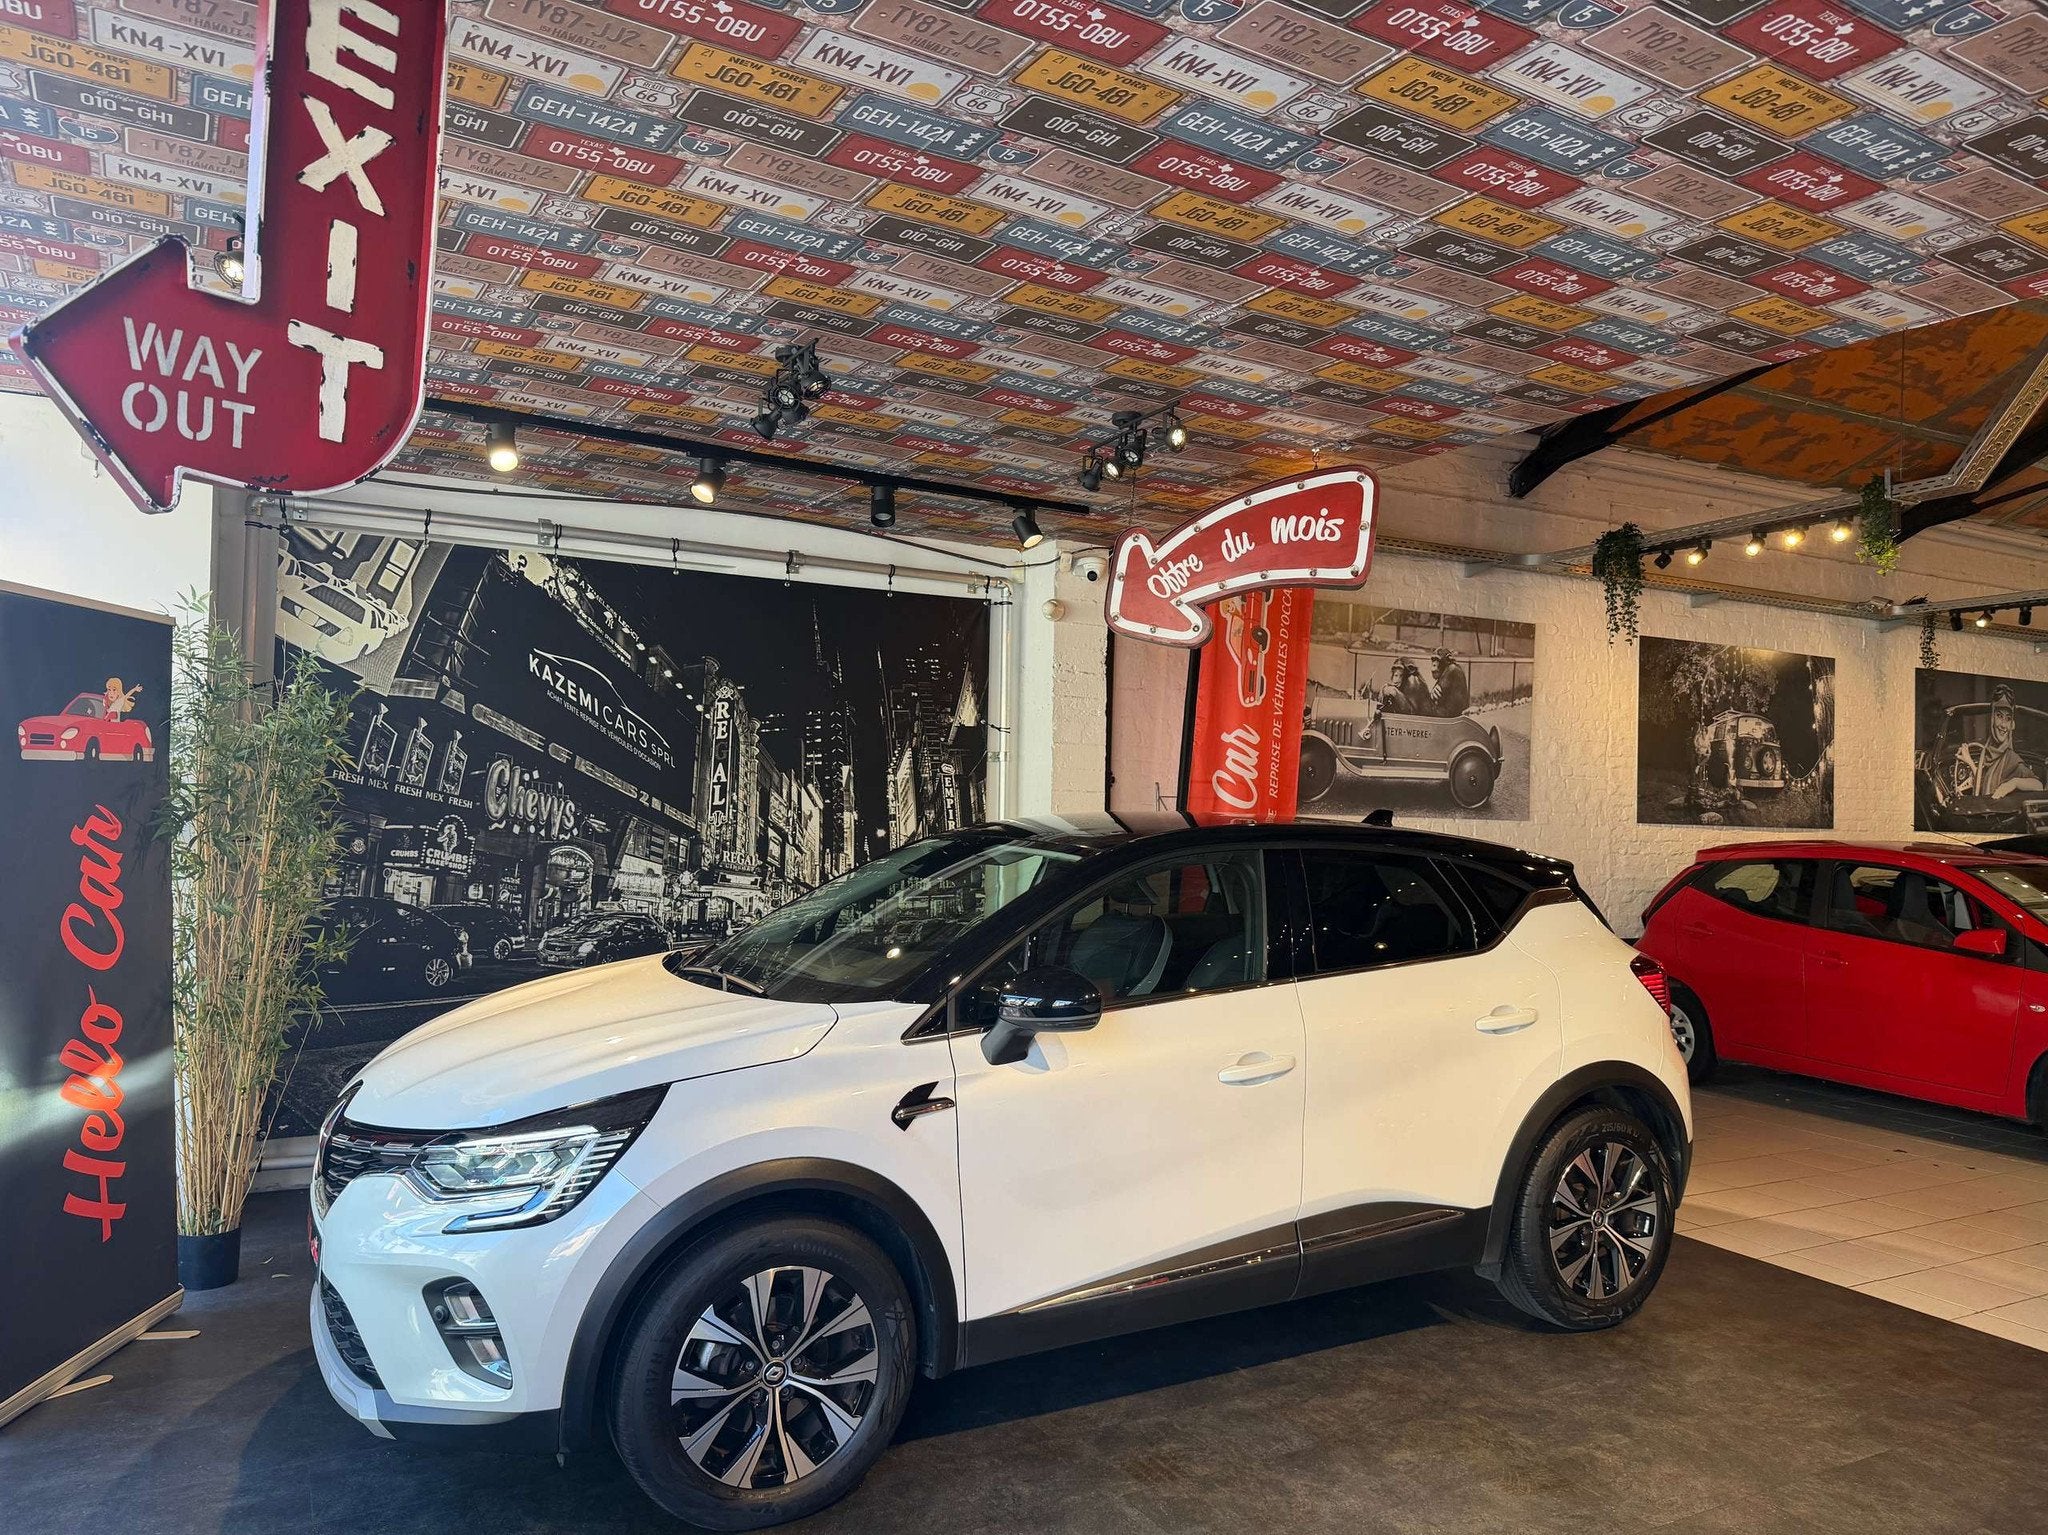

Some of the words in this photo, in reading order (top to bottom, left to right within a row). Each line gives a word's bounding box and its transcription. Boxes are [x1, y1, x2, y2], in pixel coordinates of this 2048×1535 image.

[529, 94, 637, 136] GEH-142A
[636, 89, 658, 102] 66
[967, 96, 990, 110] 66
[1297, 105, 1323, 118] 66
[78, 125, 98, 139] 15
[853, 104, 955, 145] GEH-142A
[1177, 111, 1273, 152] GEH-142A
[1628, 110, 1656, 123] 66
[1959, 115, 1989, 128] 66
[692, 140, 712, 153] 15
[998, 148, 1020, 160] 15
[1502, 117, 1592, 158] GEH-142A
[1826, 123, 1911, 163] GEH-142A
[1304, 156, 1329, 169] 15
[1611, 162, 1638, 175] 15
[1916, 166, 1946, 179] 15
[89, 233, 107, 245] 15
[288, 0, 400, 443] EXIT
[123, 316, 263, 394] WAY
[121, 381, 255, 449] OUT
[1148, 552, 1203, 598] Offre
[1221, 528, 1256, 563] du
[1270, 508, 1344, 544] mois
[1273, 639, 1290, 719] VÉHICULES
[529, 653, 600, 716] KAZEMI
[602, 705, 648, 748] CARS
[651, 743, 675, 768] SPRL
[547, 689, 563, 704] ACHAT
[563, 700, 580, 717] VENTE
[579, 711, 599, 730] REPRISE
[600, 724, 607, 735] DE
[1273, 721, 1282, 738] DE
[712, 700, 731, 806] REGAL
[1212, 722, 1262, 810] Car
[1268, 741, 1281, 799] REPRISE
[332, 769, 364, 785] FRESH
[367, 778, 389, 790] MEX
[394, 784, 423, 798] FRESH
[425, 790, 444, 802] MEX
[448, 796, 474, 809] FRESH
[484, 757, 576, 840] Chevys
[390, 849, 419, 858] CRUMBS
[426, 848, 469, 864] CRUMBS
[722, 850, 758, 866] REGAL
[60, 804, 124, 970] Car
[59, 984, 127, 1243] Hello
